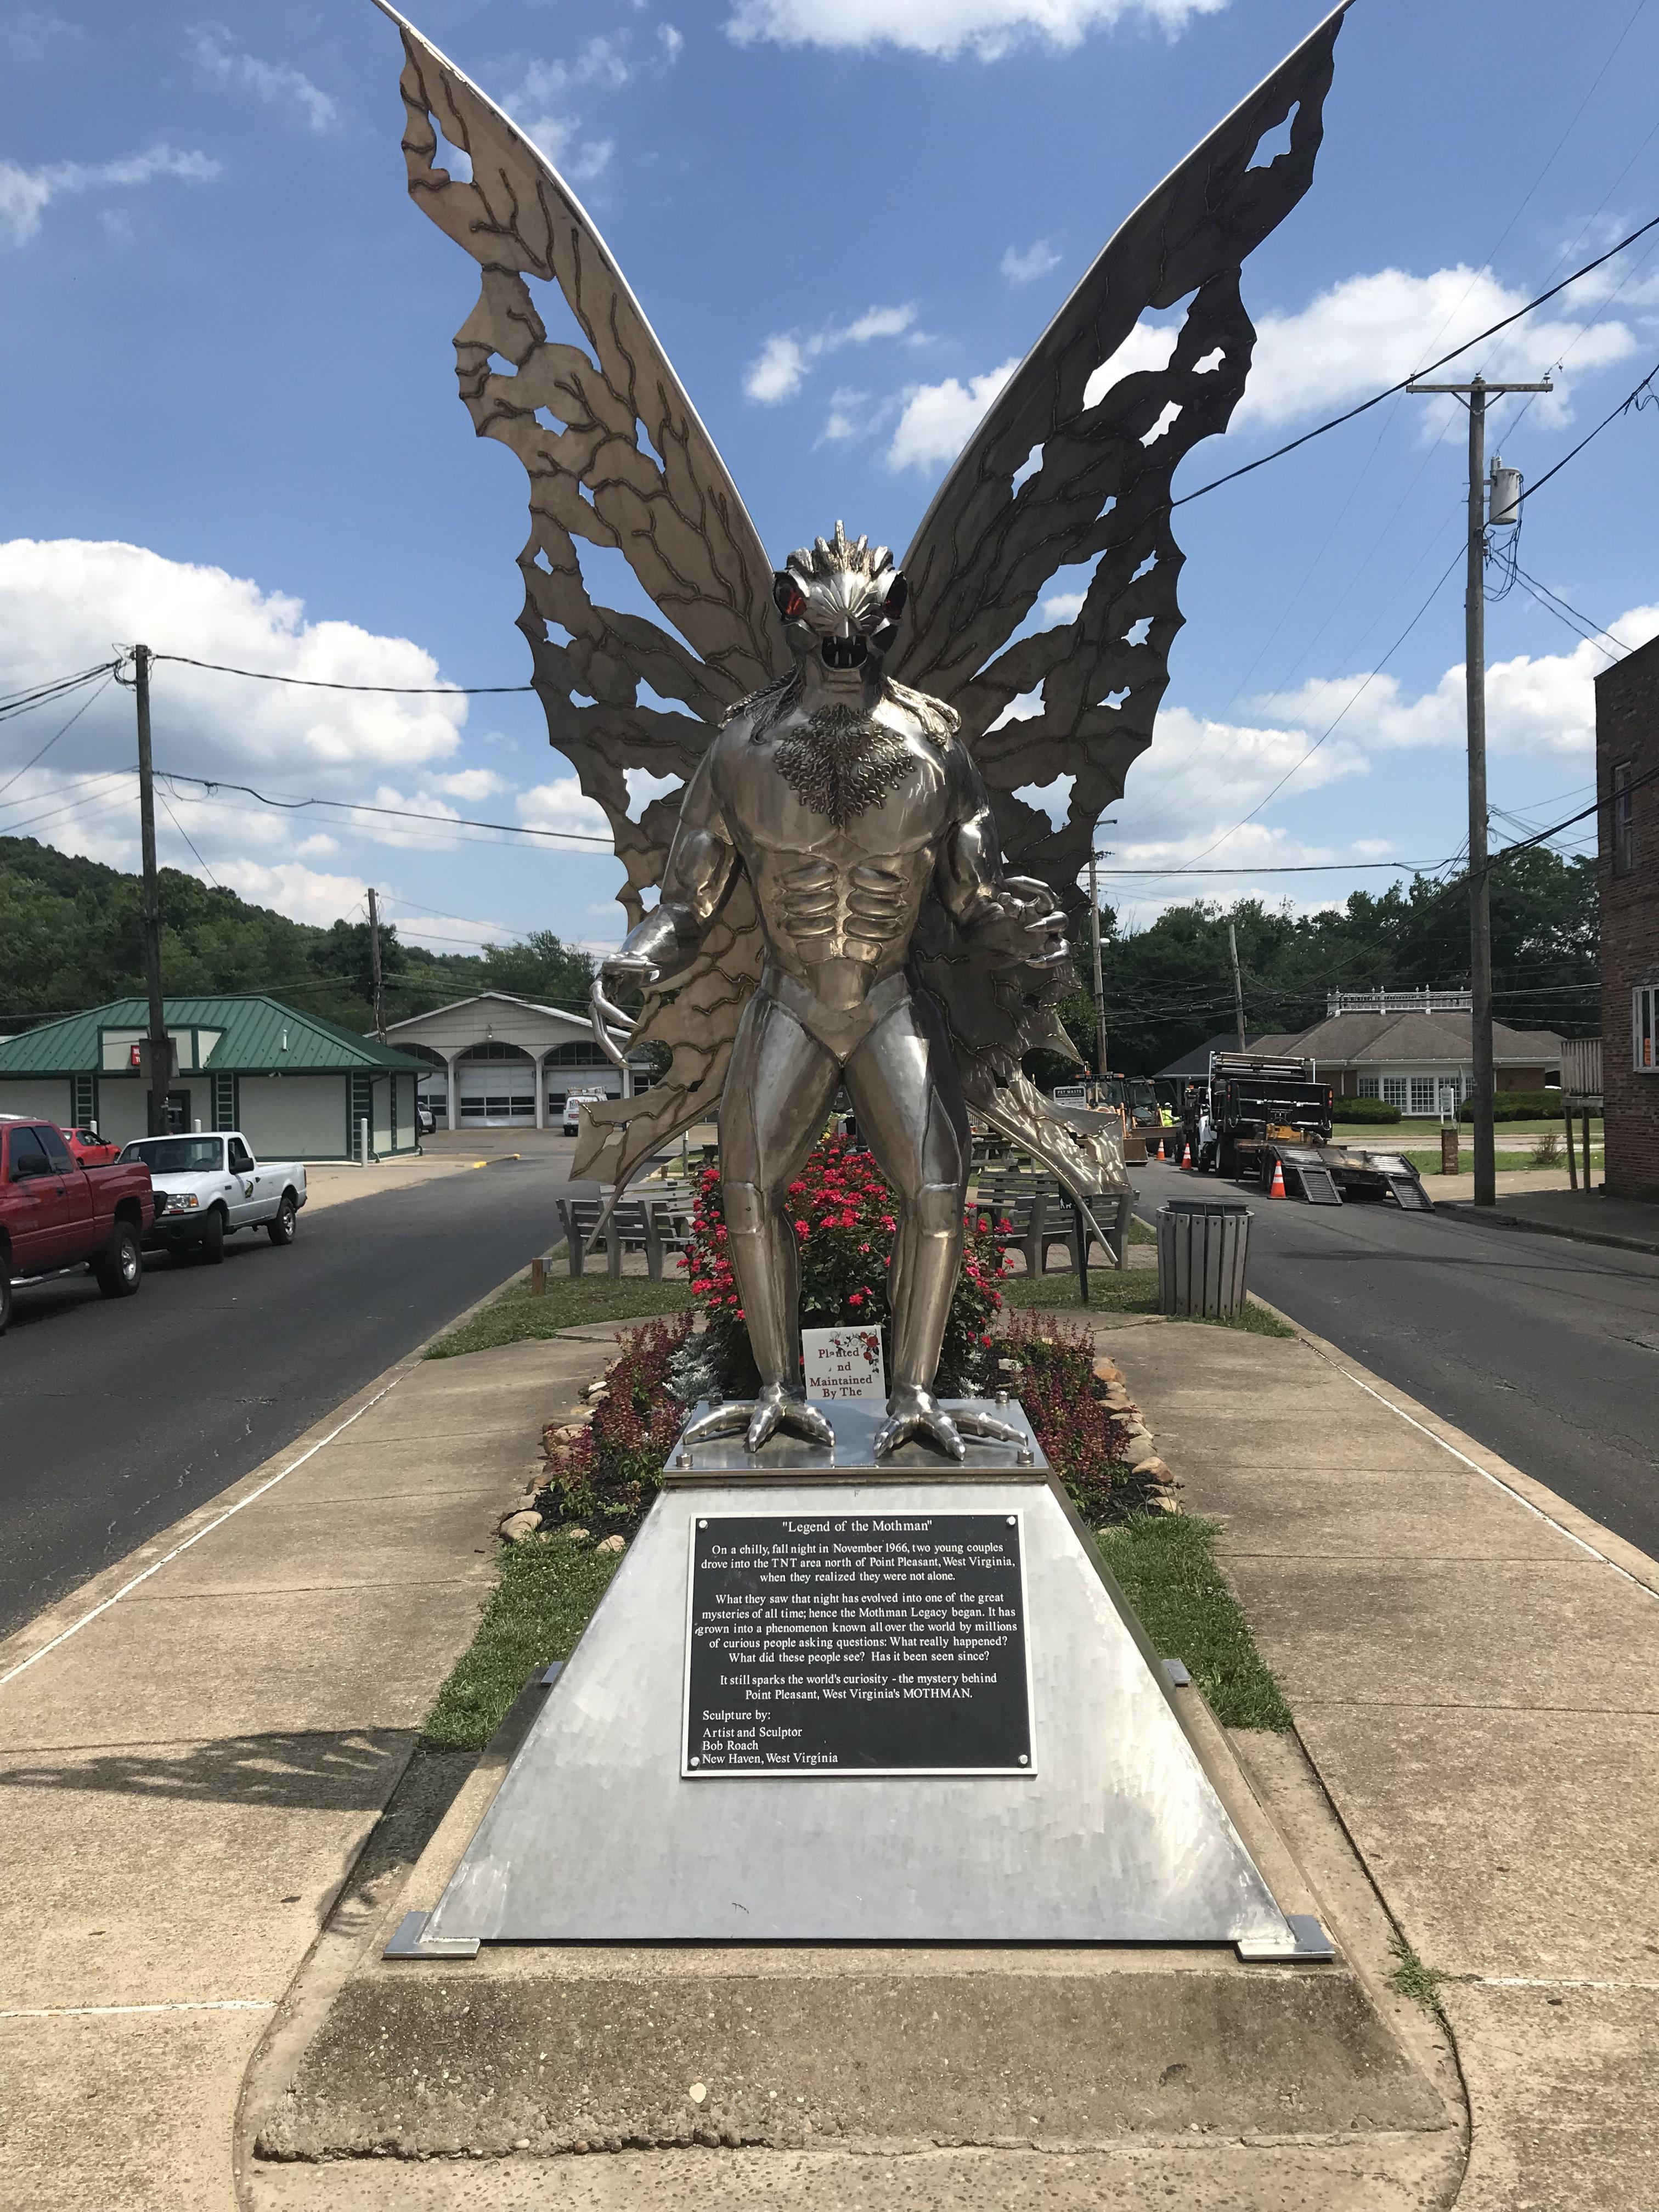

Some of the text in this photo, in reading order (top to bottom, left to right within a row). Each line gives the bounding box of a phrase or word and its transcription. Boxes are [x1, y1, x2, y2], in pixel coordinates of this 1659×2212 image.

[809, 1374, 872, 1387] Maintained
[822, 1387, 862, 1400] By The
[782, 1520, 932, 1535] "Legend of the Mothman"
[712, 1545, 727, 1554] On
[740, 1544, 770, 1556] chilly,
[772, 1543, 788, 1554] fall
[791, 1543, 816, 1556] night
[819, 1543, 829, 1553] in
[833, 1543, 883, 1553] November
[885, 1542, 910, 1554] 1966,
[912, 1544, 931, 1552] two
[934, 1544, 964, 1555] young
[967, 1542, 1003, 1554] couples
[701, 1556, 1015, 1569] drove into the TNT area north of Point Pleasant, West Virginia,
[760, 1572, 786, 1582] when
[790, 1572, 811, 1584] they
[815, 1571, 856, 1582] realized
[860, 1571, 881, 1583] they
[910, 1572, 925, 1581] not
[927, 1571, 956, 1581] alone.
[715, 1594, 743, 1604] What
[745, 1594, 766, 1606] they
[791, 1593, 811, 1604] that
[814, 1593, 839, 1606] night
[842, 1593, 859, 1603] has
[861, 1593, 899, 1603] evolved
[902, 1592, 922, 1602] into
[945, 1592, 957, 1602] of
[960, 1592, 975, 1602] the
[978, 1593, 1004, 1605] great
[702, 1606, 1016, 1622] mysteries of all time; hence the Mothman Legacy began. It has
[697, 1626, 730, 1637] grown
[733, 1623, 753, 1633] into
[766, 1623, 828, 1636] phenomenon
[832, 1622, 867, 1633] known
[870, 1622, 883, 1632] all
[884, 1624, 906, 1632] over
[909, 1621, 925, 1632] the
[927, 1621, 956, 1632] world
[959, 1621, 972, 1634] by
[975, 1621, 1018, 1632] millions
[709, 1635, 1008, 1650] of curious people asking questions: What really happened?
[729, 1652, 757, 1663] What
[759, 1652, 775, 1663] did
[779, 1652, 805, 1662] these
[808, 1651, 841, 1664] people
[843, 1651, 865, 1662] see?
[871, 1651, 891, 1662] Has
[894, 1651, 901, 1661] it
[903, 1651, 928, 1661] been
[958, 1650, 990, 1661] since?
[720, 1675, 728, 1685] It
[730, 1674, 751, 1685] still
[752, 1674, 786, 1688] sparks
[788, 1674, 804, 1684] the
[806, 1673, 841, 1684] world's
[843, 1673, 889, 1686] curiosity
[899, 1673, 915, 1684] the
[917, 1674, 959, 1686] mystery
[961, 1673, 997, 1683] behind
[746, 1688, 973, 1701] Point Pleasant, West Virginia's MOTHMAN.
[703, 1709, 771, 1723] Sculpture by:
[703, 1726, 803, 1740] Artist and Sculptor
[701, 1740, 759, 1751] Bob Roach
[702, 1752, 838, 1765] New Haven, West Virginia
